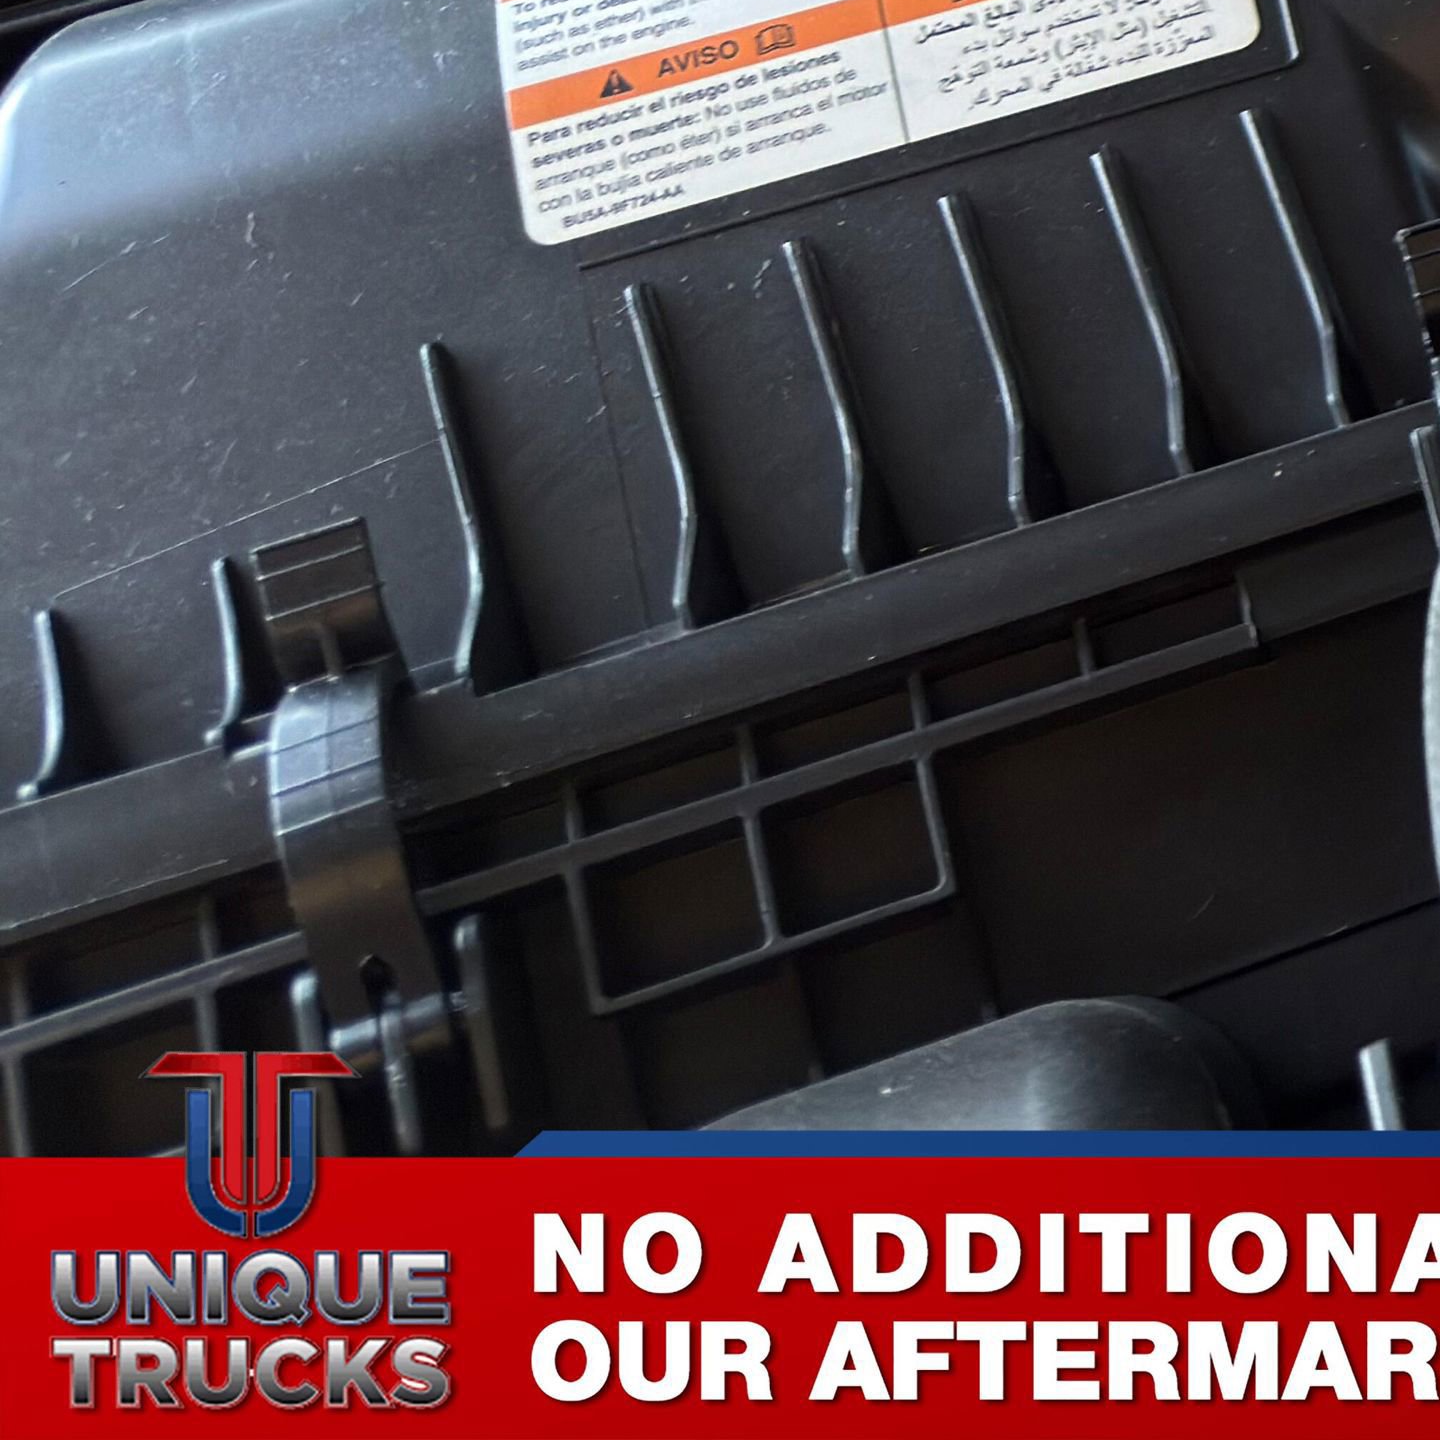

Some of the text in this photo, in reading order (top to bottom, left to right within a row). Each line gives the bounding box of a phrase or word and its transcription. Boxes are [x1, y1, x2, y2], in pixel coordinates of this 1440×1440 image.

[514, 28, 563, 54] (such
[568, 24, 589, 38] as
[593, 6, 645, 32] ether)
[517, 12, 695, 71] assist on the engine.
[571, 3, 594, 18] or
[655, 37, 740, 79] AVISO
[527, 47, 841, 147] Para reducir el riesgo de lesiones
[530, 66, 857, 169] severas o muerte: No use fluidos de
[534, 80, 889, 195] arranque (como éter) si arranca el motor
[538, 193, 572, 213] con
[576, 185, 591, 203] la
[644, 151, 713, 184] caliente
[717, 143, 743, 163] de
[746, 121, 832, 158] arranque.
